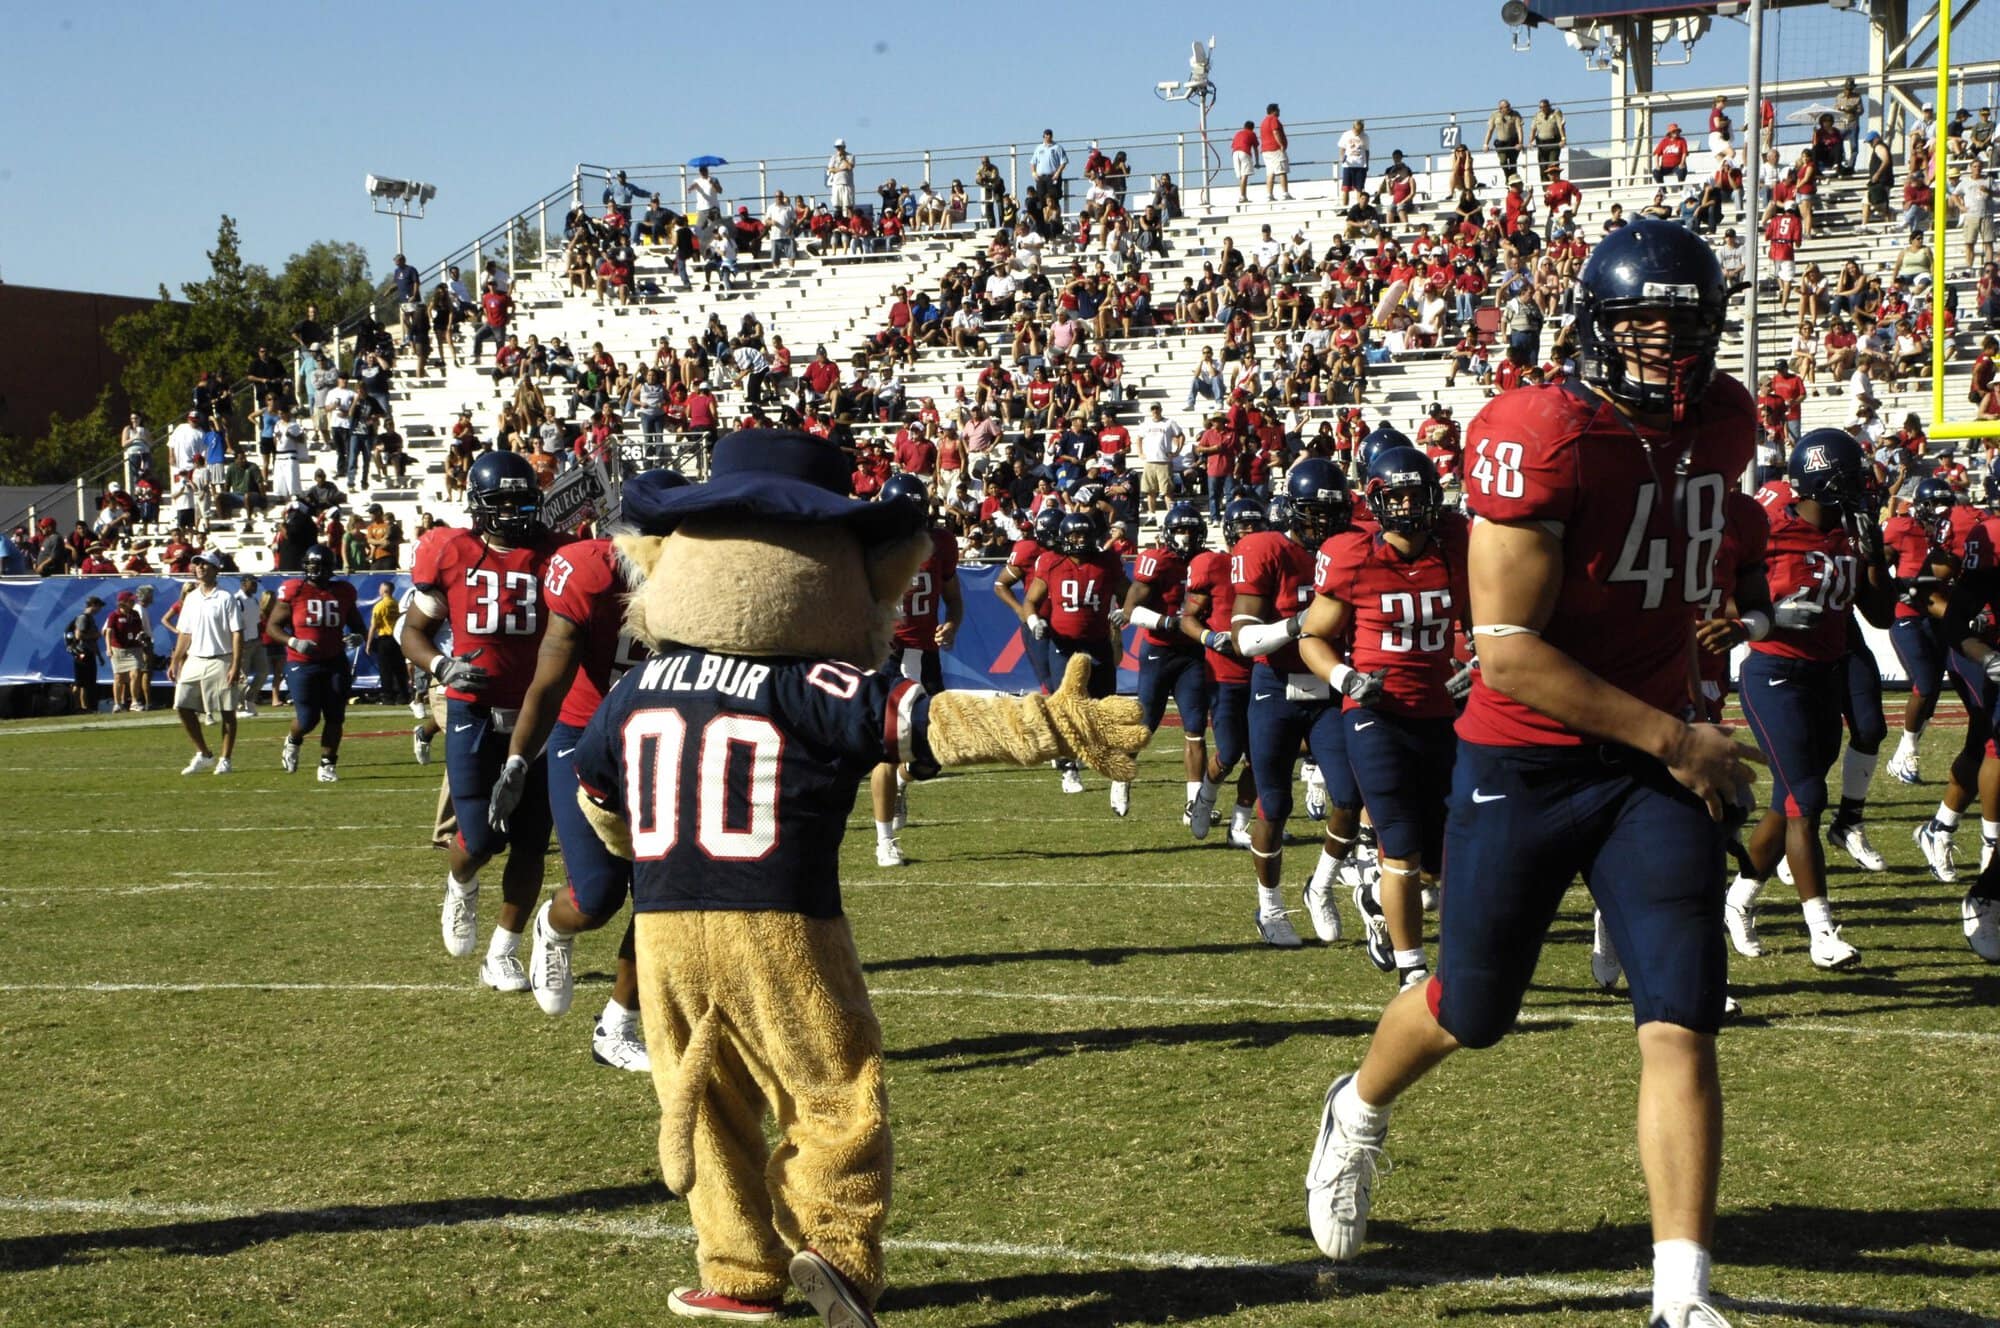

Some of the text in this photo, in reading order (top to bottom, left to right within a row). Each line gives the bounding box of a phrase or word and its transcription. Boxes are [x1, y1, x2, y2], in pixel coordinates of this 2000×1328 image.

[1442, 127, 1459, 147] 27
[620, 445, 643, 461] 26
[1073, 442, 1085, 460] 7
[1804, 445, 1832, 473] A
[1470, 437, 1525, 500] 48
[1607, 472, 1726, 610] 48
[1137, 555, 1157, 577] 10
[1231, 555, 1246, 584] 21
[465, 567, 538, 635] 33
[1061, 579, 1101, 613] 94
[305, 599, 340, 627] 96
[1380, 588, 1452, 653] 35
[637, 653, 770, 700] WILBUR
[620, 707, 785, 862] 00
